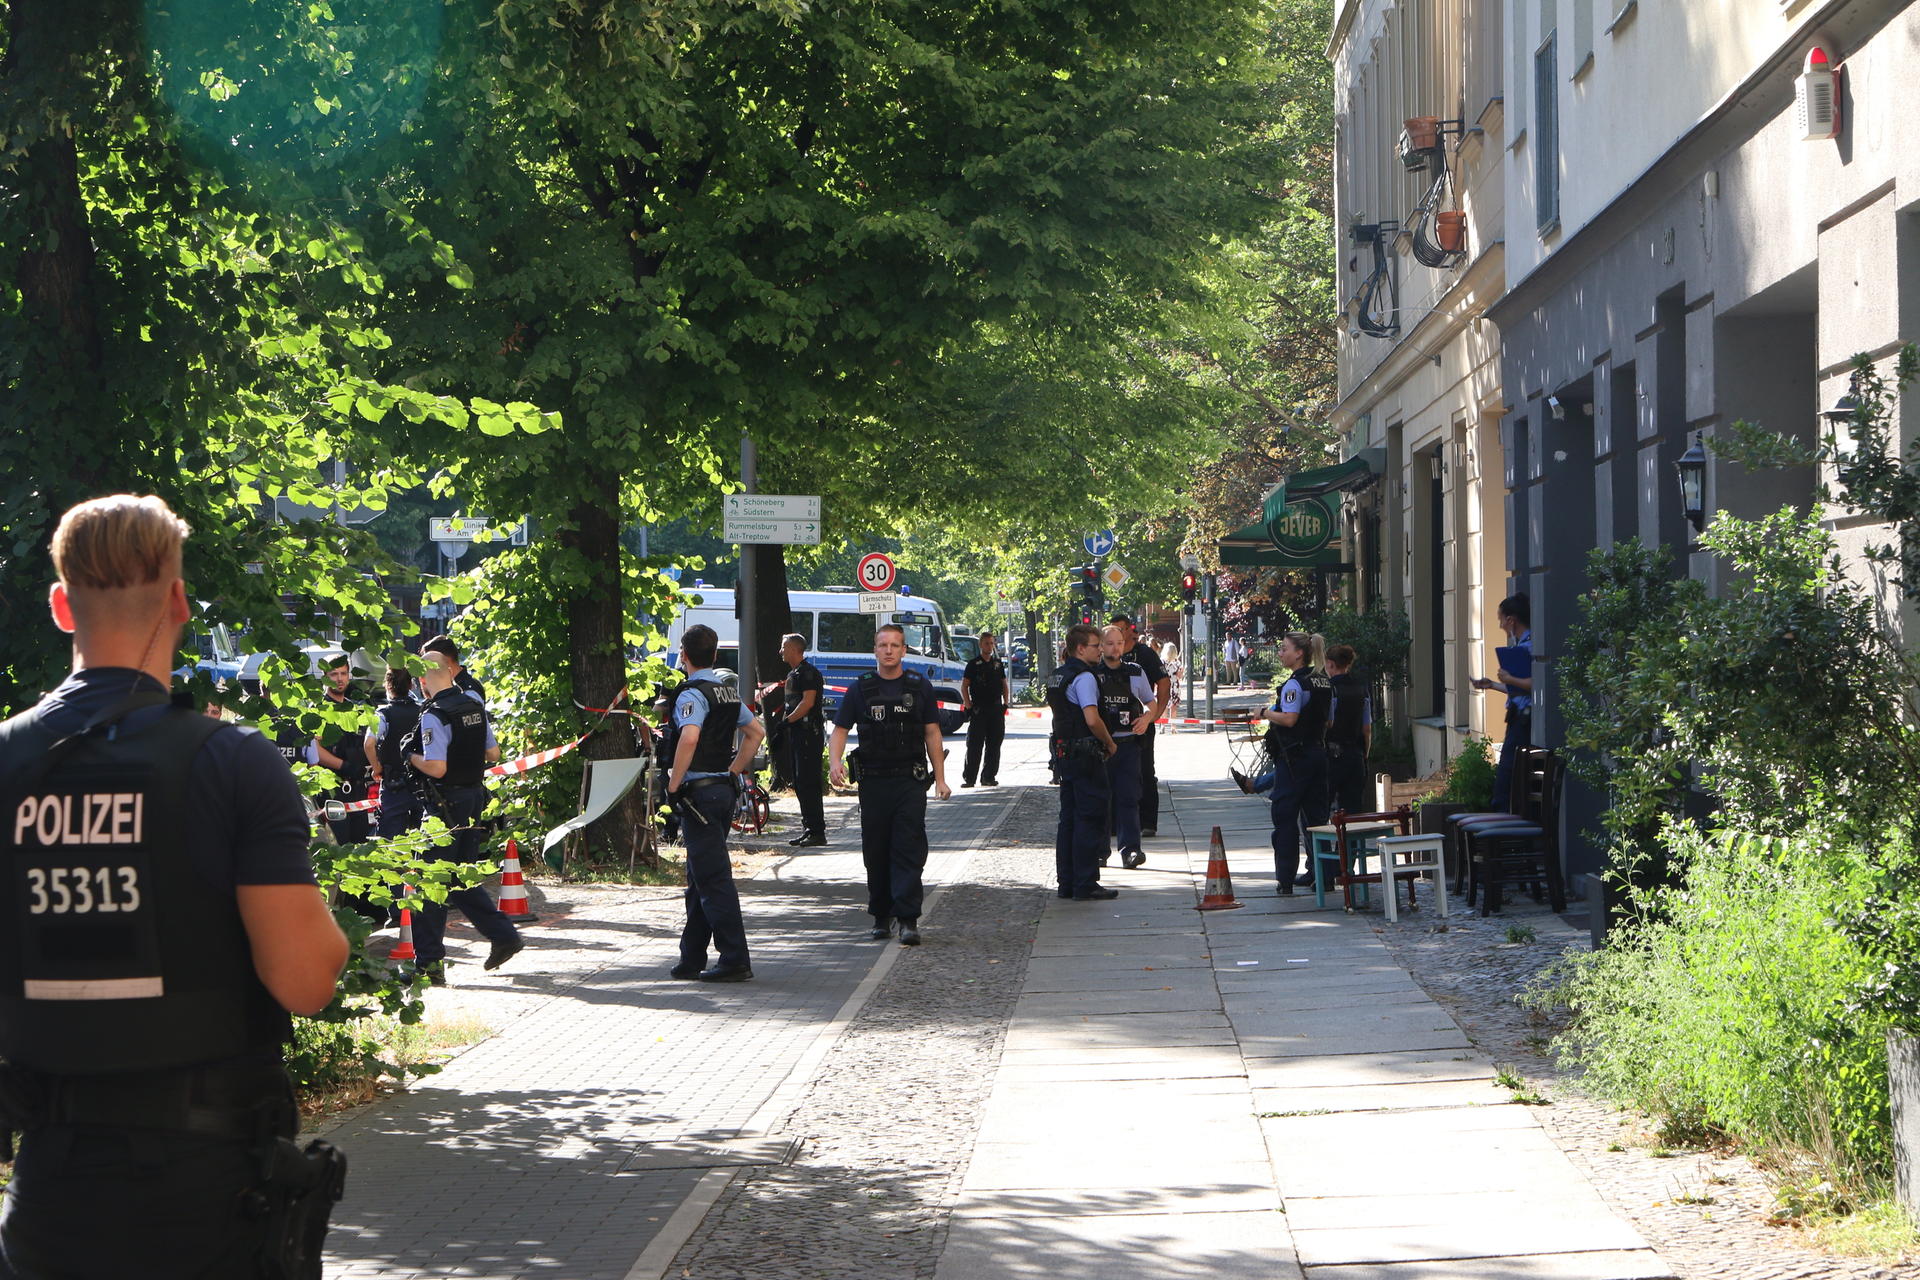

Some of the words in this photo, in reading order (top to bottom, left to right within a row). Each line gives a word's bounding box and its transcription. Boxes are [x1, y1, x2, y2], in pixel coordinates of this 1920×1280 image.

[743, 498, 785, 507] Schöneberg
[728, 522, 778, 531] Rummelsburg
[1280, 514, 1321, 537] JEVER
[729, 532, 770, 541] Alt-Treptow
[866, 564, 887, 581] 30
[862, 595, 892, 603] Lärmschutz
[14, 792, 144, 845] POLIZEI
[27, 865, 141, 914] 35313
